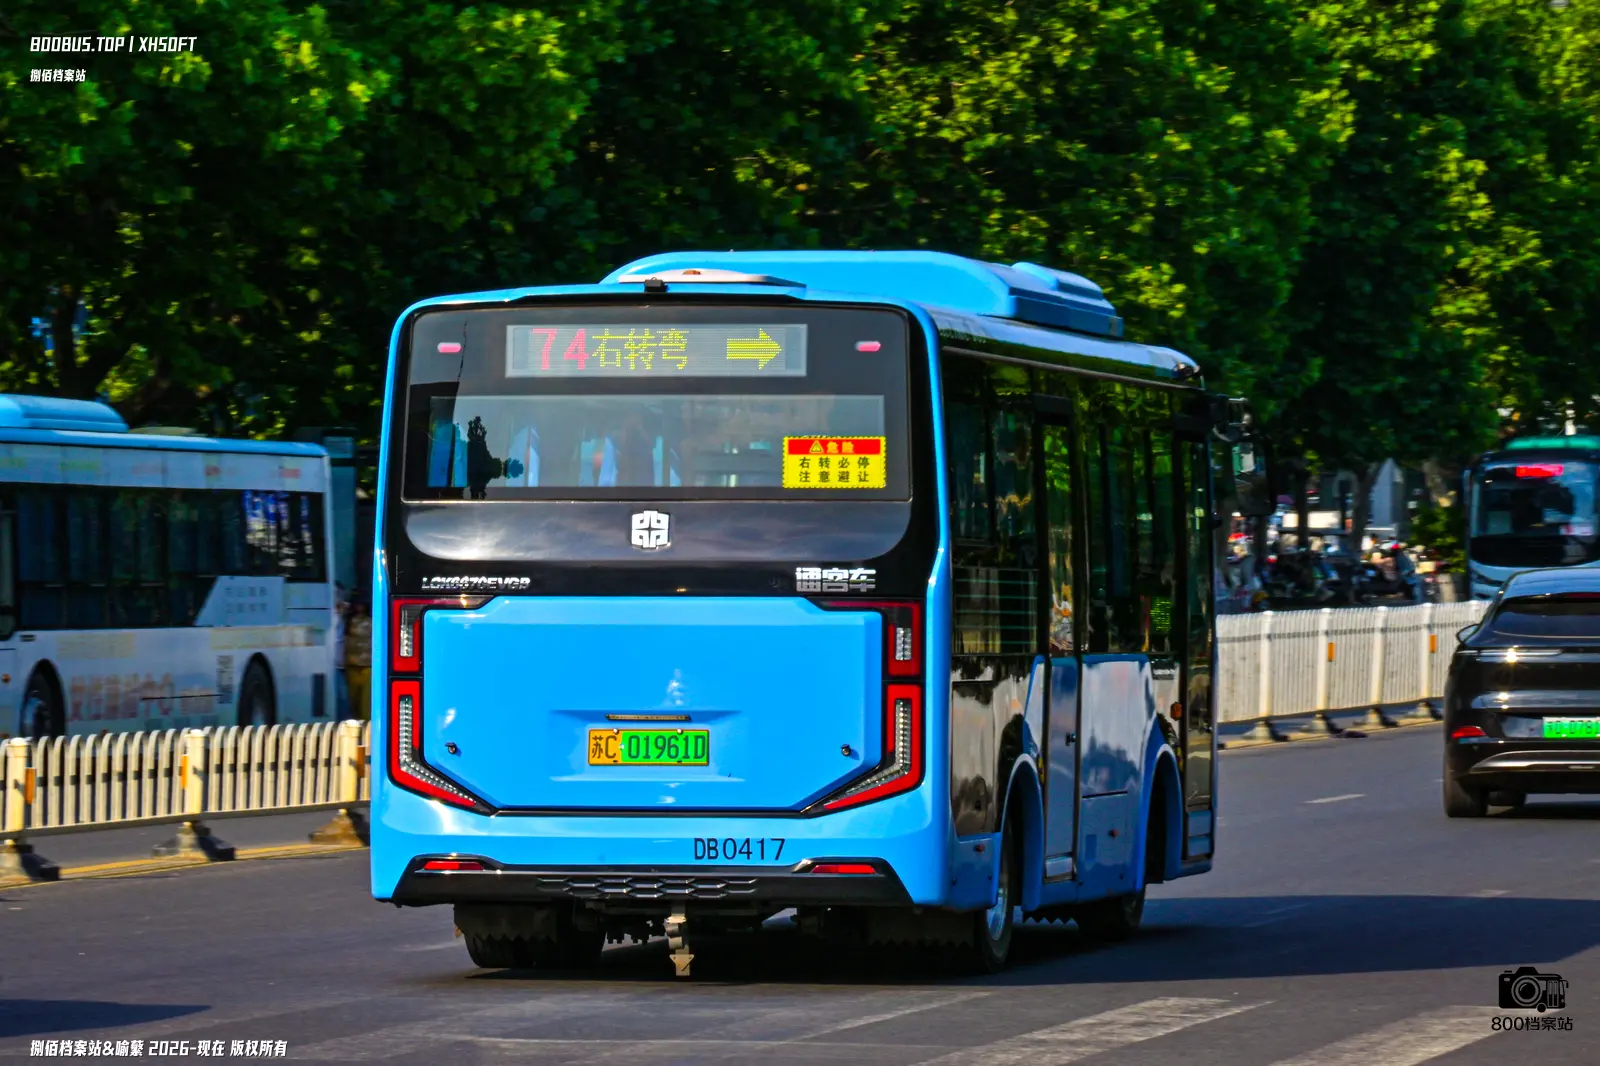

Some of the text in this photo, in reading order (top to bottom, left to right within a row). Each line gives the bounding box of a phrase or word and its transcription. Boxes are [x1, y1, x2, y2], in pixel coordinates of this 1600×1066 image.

[531, 328, 689, 370] 74 右转弯
[798, 457, 870, 469] 右转必停
[798, 471, 869, 483] 注意避让
[795, 567, 877, 592] 通客车
[591, 735, 706, 759] 苏C 01961D
[693, 837, 786, 861] DB0417
